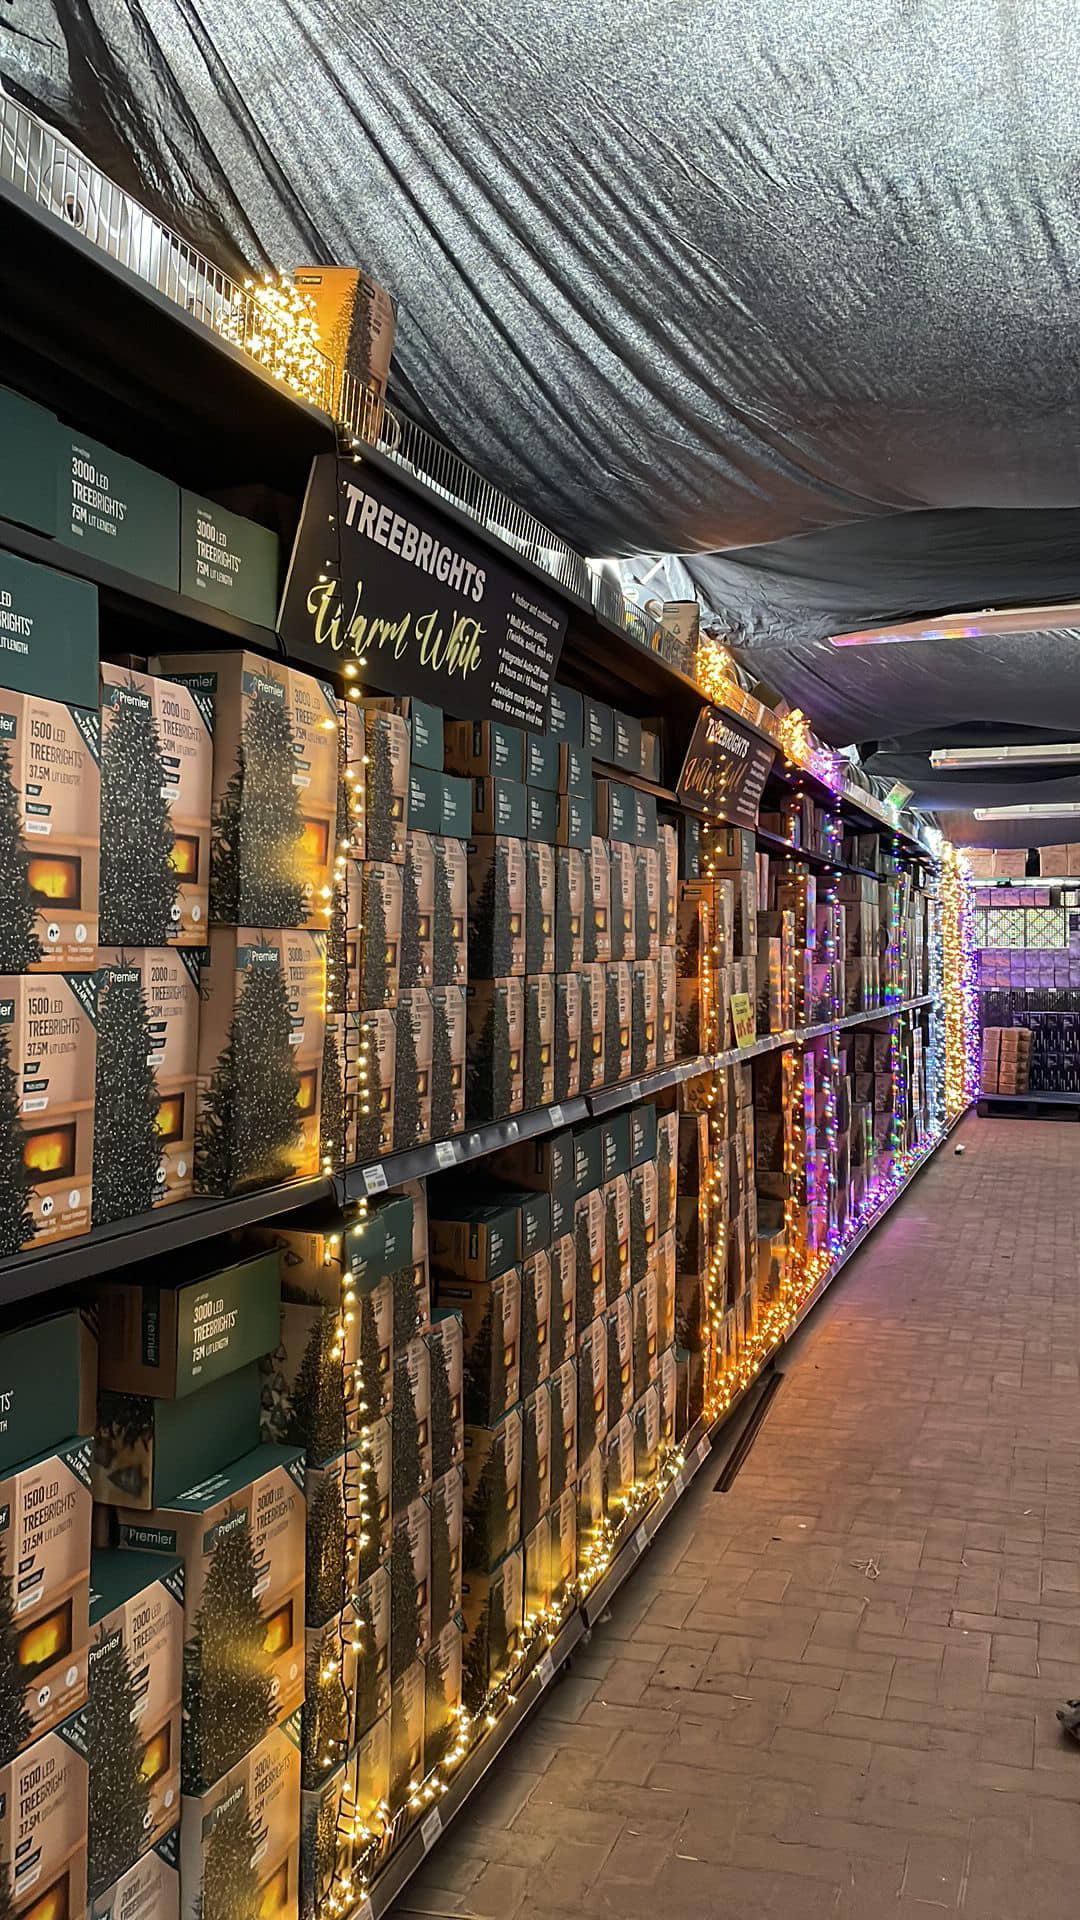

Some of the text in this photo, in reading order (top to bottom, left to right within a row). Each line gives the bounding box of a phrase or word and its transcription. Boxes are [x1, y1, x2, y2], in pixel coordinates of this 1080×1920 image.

[72, 456, 108, 490] 3000 LED
[72, 480, 125, 520] TREEBRIGHTS
[72, 502, 87, 523] 75M
[88, 514, 96, 527] LIT
[196, 519, 226, 547] 3000 LED
[344, 484, 486, 602] TREEBRIGHTS
[196, 539, 240, 572] TREEBRIGHTS
[196, 560, 209, 577] 75M
[307, 580, 487, 680] Warm White
[7, 638, 29, 655] LENGTH
[120, 691, 150, 709] Premier
[257, 680, 283, 698] Premier
[162, 700, 191, 720] 2000 LED
[31, 720, 52, 740] 1500
[53, 728, 65, 742] LED
[30, 742, 82, 768] TREEBRIGHTS
[29, 765, 50, 781] 37.5M
[252, 950, 278, 961] Premier
[110, 970, 138, 982] Premier
[152, 967, 168, 981] 2000
[28, 997, 49, 1015] 1500
[50, 1000, 63, 1013] LED
[28, 1017, 80, 1038] TREEBRIGHTS
[27, 1042, 48, 1056] 37.5M
[193, 1299, 224, 1323] 3000 LED
[193, 1310, 236, 1344] TREEBRIGHTS
[192, 1344, 206, 1363] 75M
[24, 1481, 58, 1512] 1500 LED
[23, 1491, 76, 1534] TREEBRIGHTS
[218, 1513, 246, 1536] Premier
[22, 1531, 44, 1554] 37.5M
[129, 1528, 172, 1545] Premier
[133, 1607, 150, 1633] 2000
[89, 1636, 120, 1665] Premier
[20, 1758, 55, 1796] 1500 LED
[19, 1766, 71, 1818] TREEBRIGHT
[216, 1786, 244, 1819] Premier
